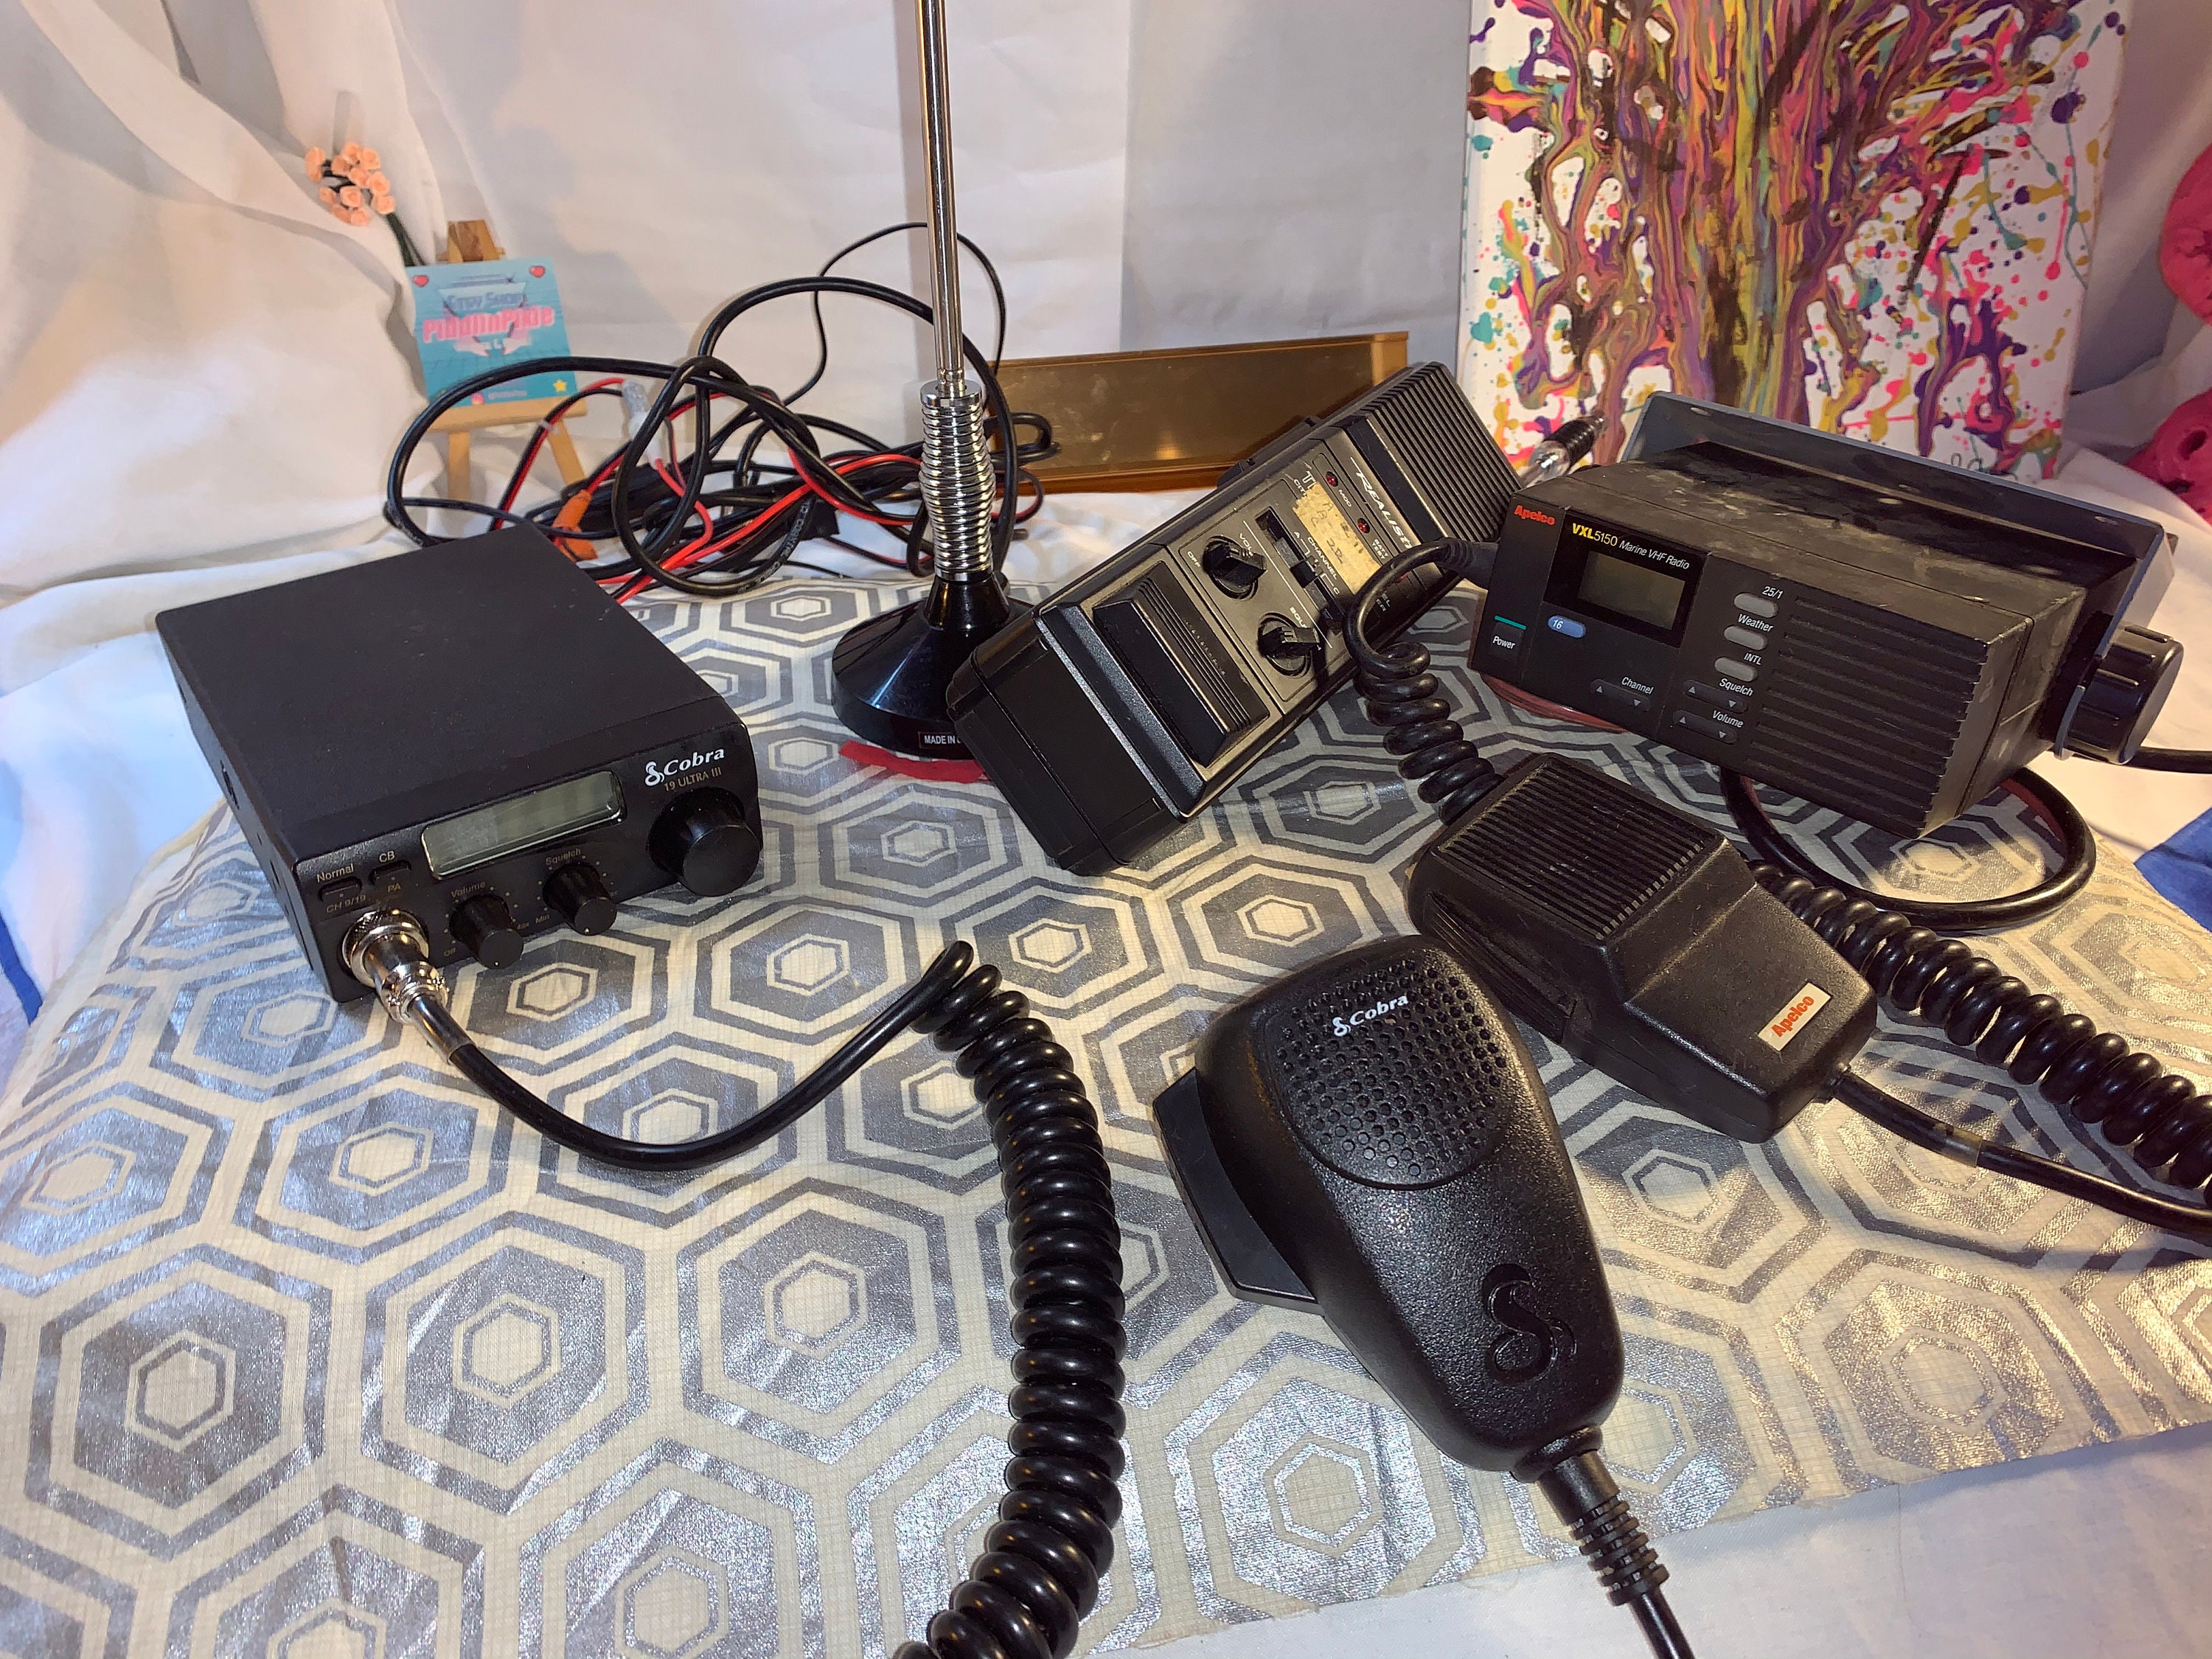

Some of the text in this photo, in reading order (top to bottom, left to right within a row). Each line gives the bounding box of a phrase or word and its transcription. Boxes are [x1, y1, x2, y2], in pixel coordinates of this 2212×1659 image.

[1338, 489, 1352, 507] MOD
[1514, 504, 1556, 526] Apelco
[1293, 531, 1301, 539] A
[1572, 523, 1690, 570] VXL5150 Marine VHF Radio
[1187, 550, 1201, 568] OFF
[1307, 536, 1338, 580] CHANNEL
[1762, 585, 1784, 599] 25/1
[1552, 619, 1564, 630] 16
[1738, 613, 1774, 633] Weather
[1492, 636, 1516, 650] Power
[1744, 653, 1762, 665] INTL
[1621, 677, 1655, 695] Channel
[1719, 678, 1753, 697] Squelch
[1712, 710, 1744, 728] Volume
[924, 734, 947, 745] MADE
[947, 735, 956, 744] IN
[664, 748, 725, 776] Cobra
[664, 767, 722, 792] 19 ULTRA III
[379, 850, 395, 863] CB
[546, 847, 581, 866] Squelch
[316, 863, 354, 883] Normal
[387, 883, 401, 894] PA
[451, 881, 486, 898] Volume
[326, 902, 342, 914] CH
[535, 914, 550, 924] Min
[443, 947, 456, 957] Off
[1349, 995, 1409, 1026] Cobra
[1771, 996, 1815, 1037] Apelco
